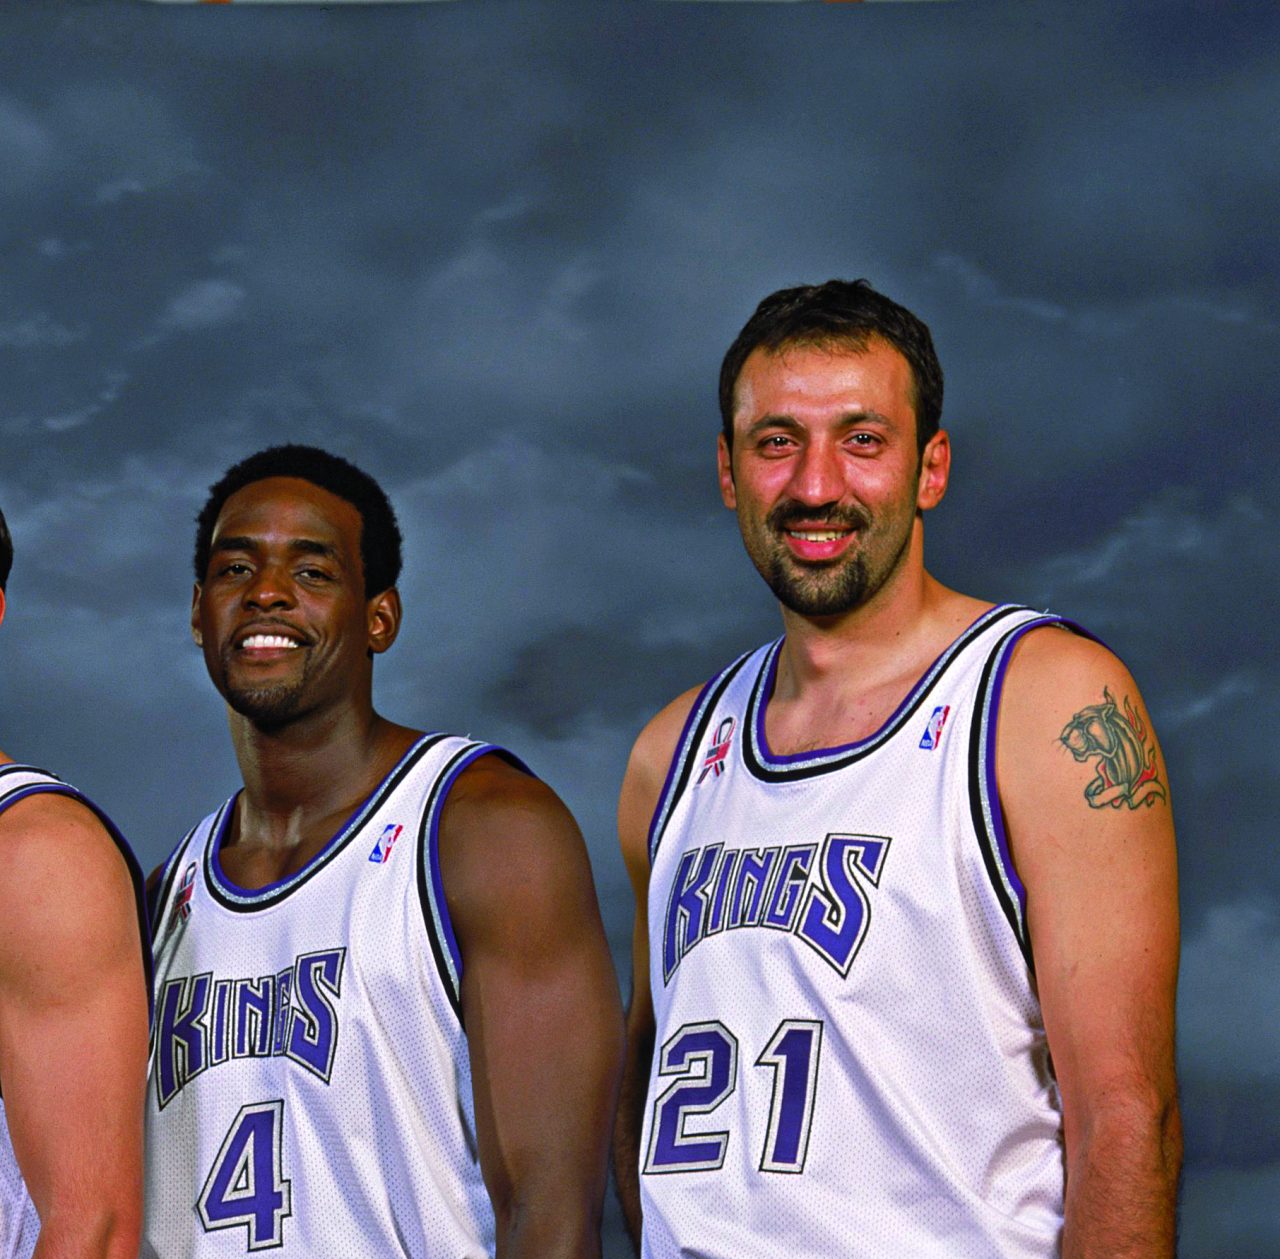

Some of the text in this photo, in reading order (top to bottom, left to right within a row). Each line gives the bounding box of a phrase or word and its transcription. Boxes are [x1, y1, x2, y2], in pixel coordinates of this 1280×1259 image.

[663, 833, 892, 988] KINGS
[155, 947, 347, 1112] KINGS
[642, 1019, 824, 1175] 21
[196, 1098, 292, 1252] 4
